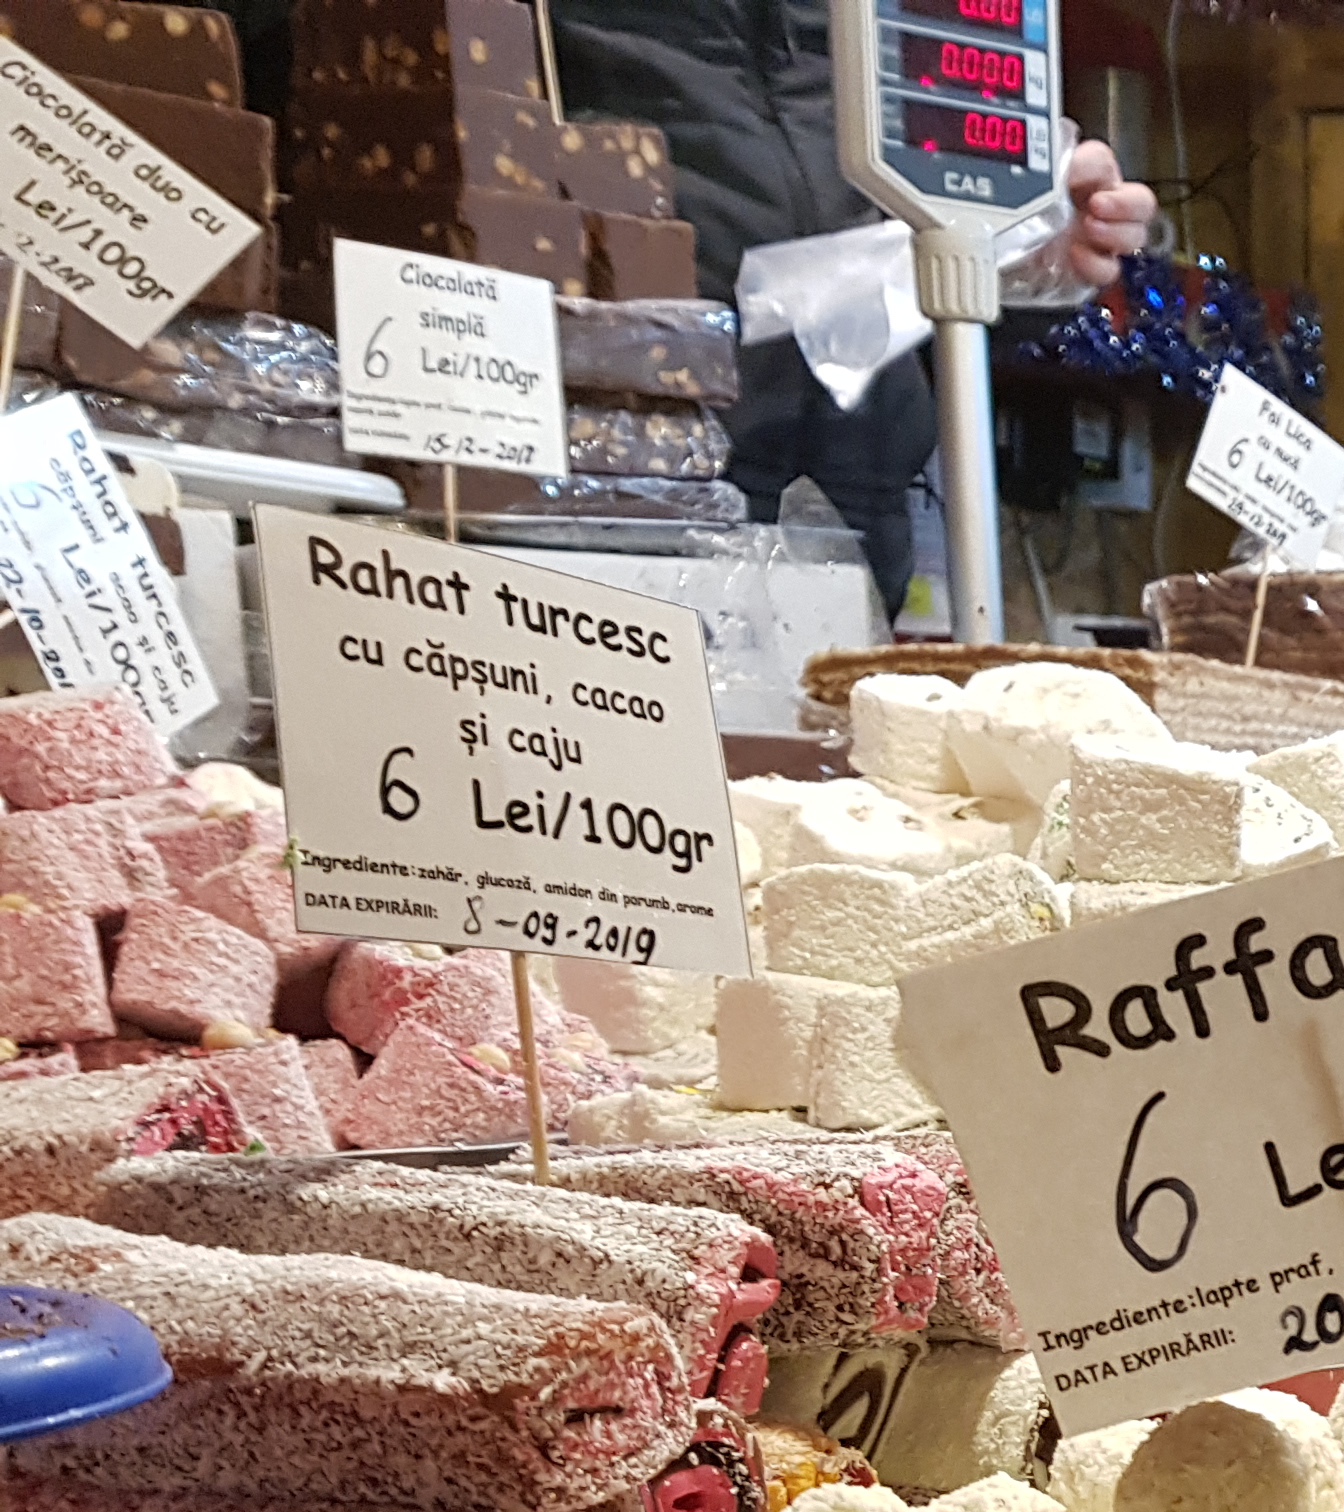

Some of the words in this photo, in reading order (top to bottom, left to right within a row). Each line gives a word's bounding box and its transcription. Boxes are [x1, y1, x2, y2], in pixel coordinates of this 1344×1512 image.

[1, 60, 134, 160] Ciocolată
[133, 163, 184, 203] duo
[190, 206, 227, 235] cu
[9, 123, 149, 231] merișoare
[944, 171, 992, 196] CAS
[13, 178, 175, 302] Lei/100gr
[400, 262, 498, 301] Ciocolată
[364, 316, 393, 378] 6
[421, 346, 540, 394] Lei/100gr
[419, 307, 486, 340] simplă
[1227, 437, 1249, 469] 6
[1254, 461, 1328, 528] Lei/100gr
[68, 428, 131, 535] Rahat
[130, 553, 197, 689] turcesc
[308, 535, 472, 616] Rahat
[494, 582, 671, 665] turcesc
[339, 633, 384, 667] cu
[572, 677, 666, 724] cacao
[459, 713, 489, 756] și
[507, 728, 583, 772] caju
[378, 746, 420, 821] 6
[471, 778, 715, 873] Lei/100gr
[304, 892, 352, 910] DATA
[355, 897, 439, 919] EXPIRĂRII:
[544, 883, 593, 900] amidon
[599, 887, 618, 904] din
[1115, 1091, 1200, 1273] 6
[1269, 1252, 1335, 1293] praf,
[1054, 1361, 1119, 1393] DATA
[1121, 1327, 1237, 1374] EXPIRĂRII:
